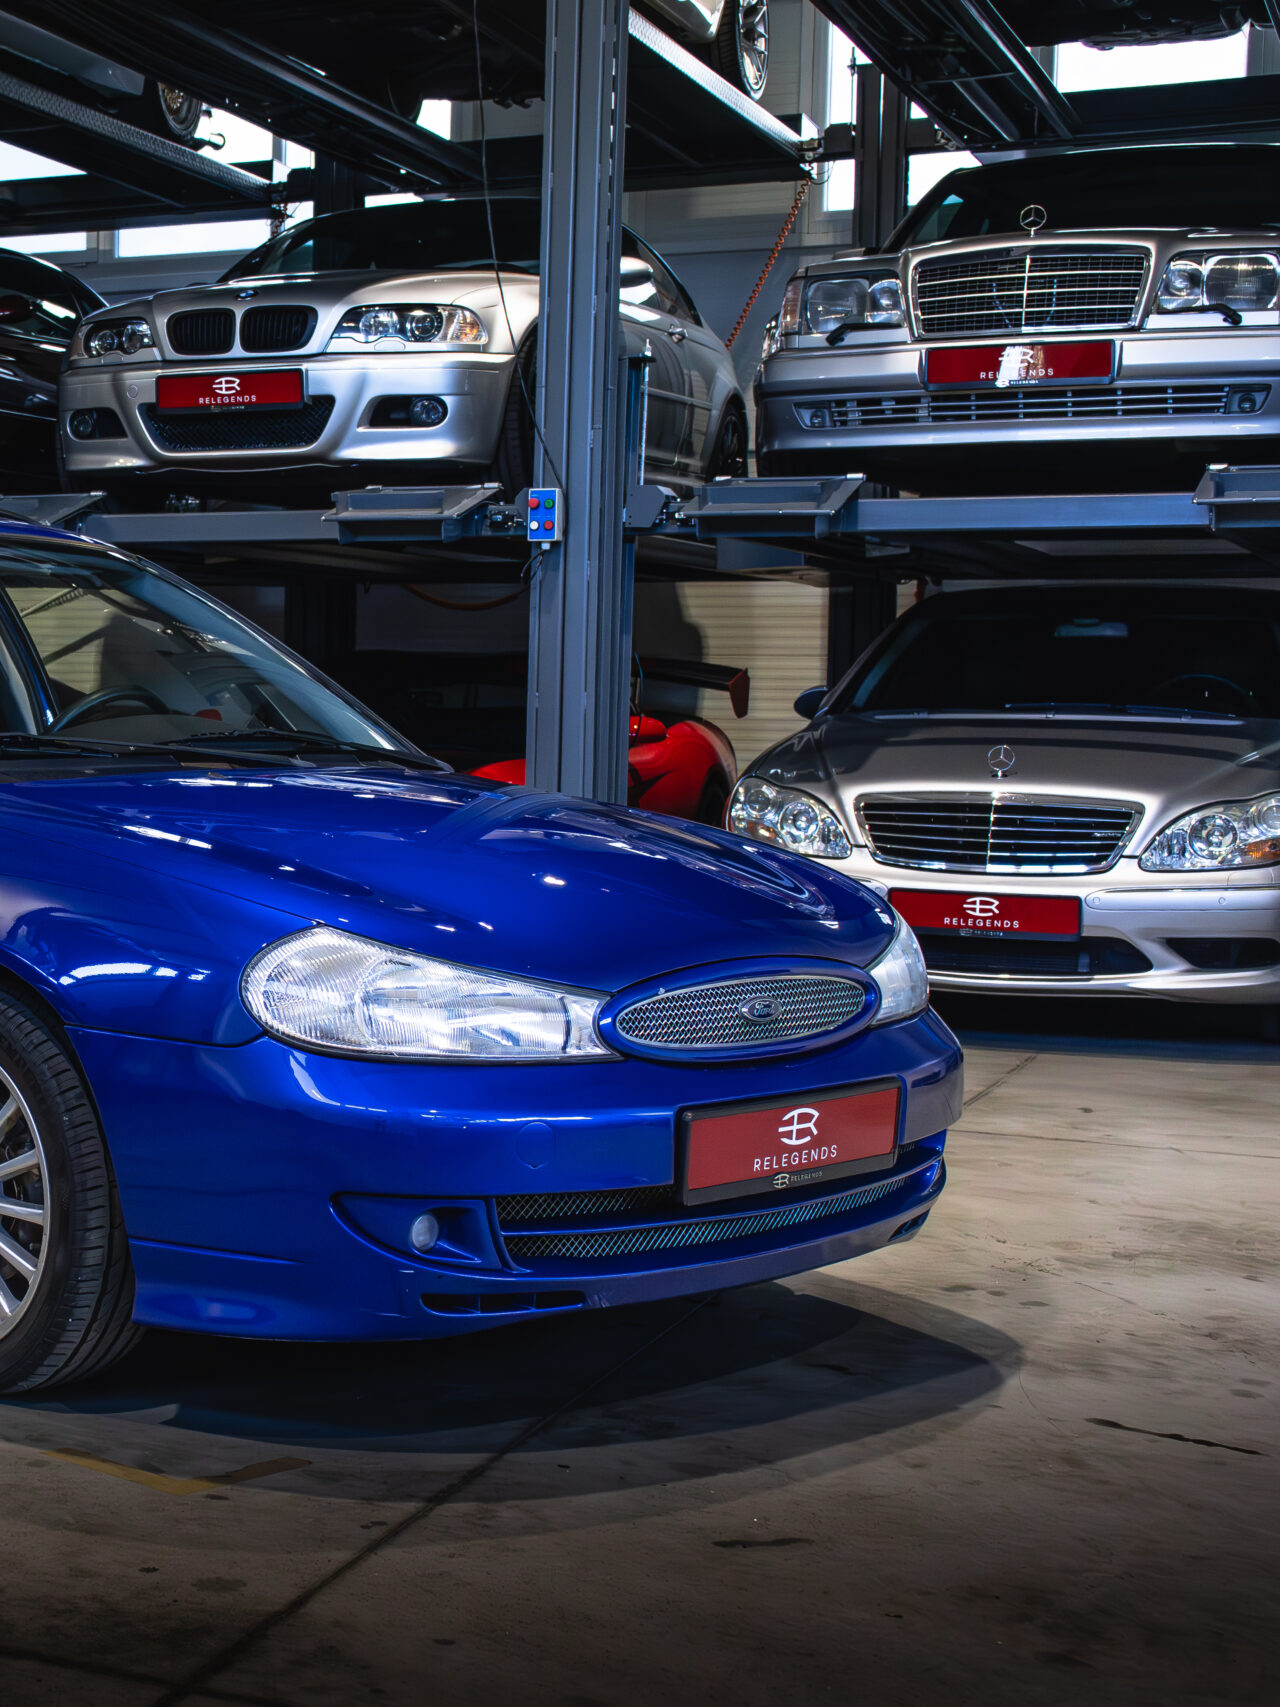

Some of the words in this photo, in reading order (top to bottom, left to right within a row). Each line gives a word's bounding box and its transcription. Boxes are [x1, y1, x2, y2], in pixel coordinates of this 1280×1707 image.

[980, 368, 1054, 379] RELENDS
[198, 395, 257, 404] RELEGENDS
[943, 917, 1019, 928] RELEGENDS
[753, 1144, 838, 1172] RELEGENDS
